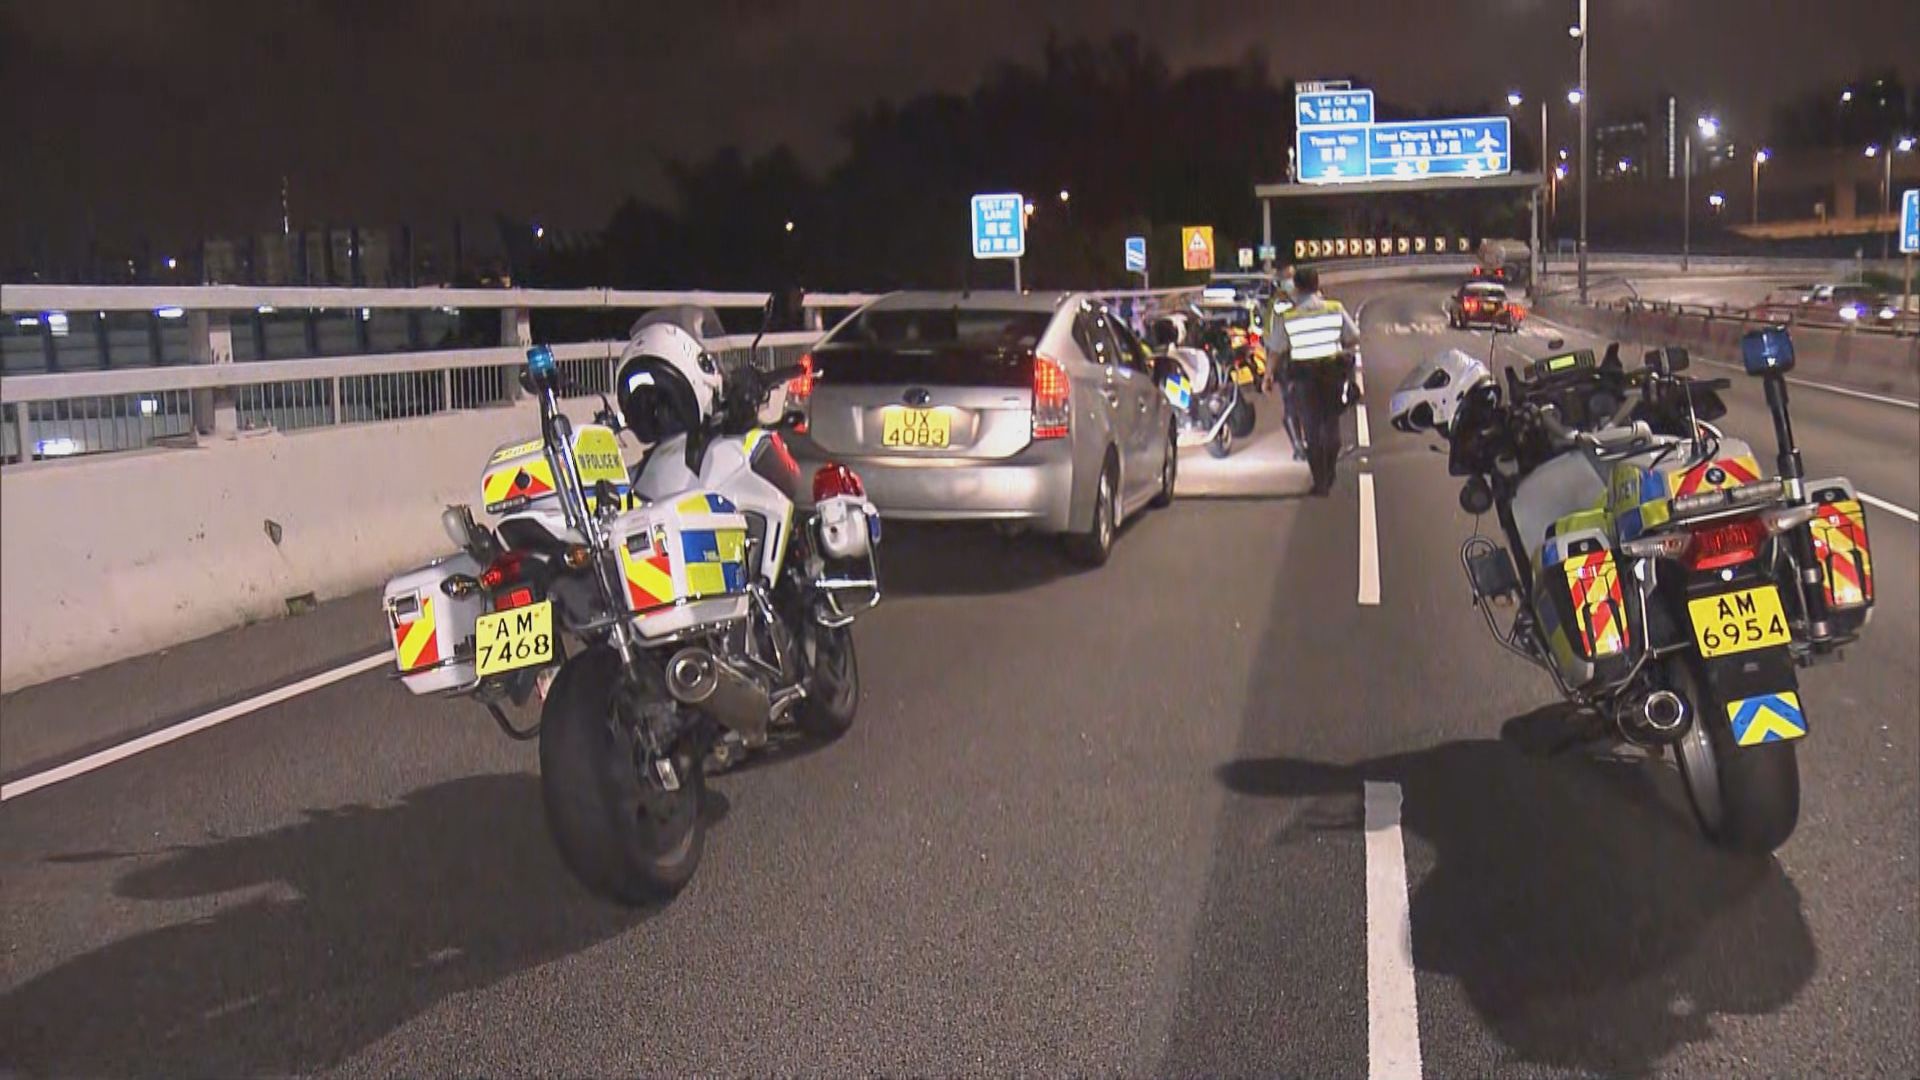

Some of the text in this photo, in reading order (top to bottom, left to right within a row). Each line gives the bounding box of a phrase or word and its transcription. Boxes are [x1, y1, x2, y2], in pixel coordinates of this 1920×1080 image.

[1460, 127, 1476, 138] Tin
[904, 410, 930, 427] UX
[889, 427, 944, 446] 4083
[586, 454, 615, 469] POLICE
[1717, 592, 1756, 620] AM
[496, 611, 532, 640] AM
[1703, 614, 1784, 649] 6954
[479, 634, 549, 669] 7468
